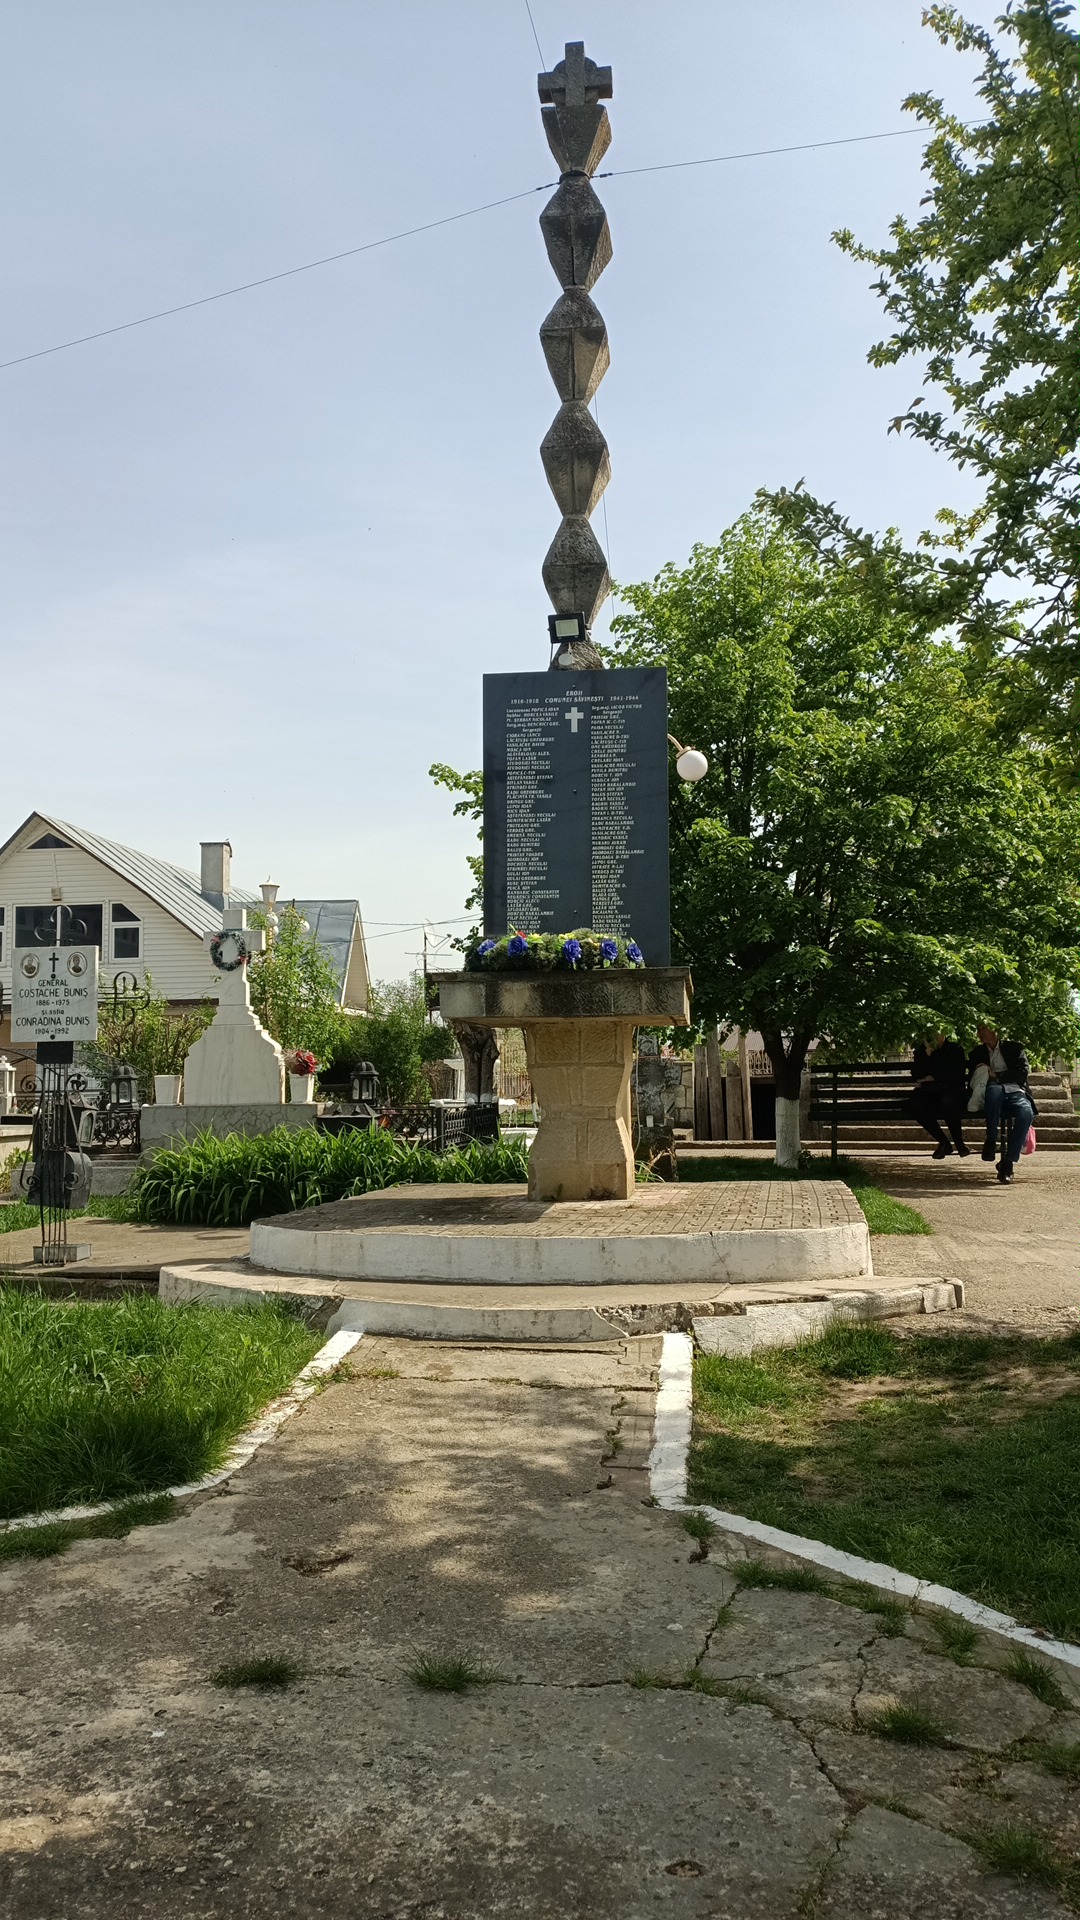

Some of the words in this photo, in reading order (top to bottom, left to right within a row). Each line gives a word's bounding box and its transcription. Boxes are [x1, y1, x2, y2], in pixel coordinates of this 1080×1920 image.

[37, 979, 69, 987] GENERAL
[19, 988, 60, 998] COSTACHE
[63, 987, 89, 998] BUNIȘ
[15, 1017, 62, 1026] CONRADINA
[65, 1016, 90, 1026] BUNIȘ
